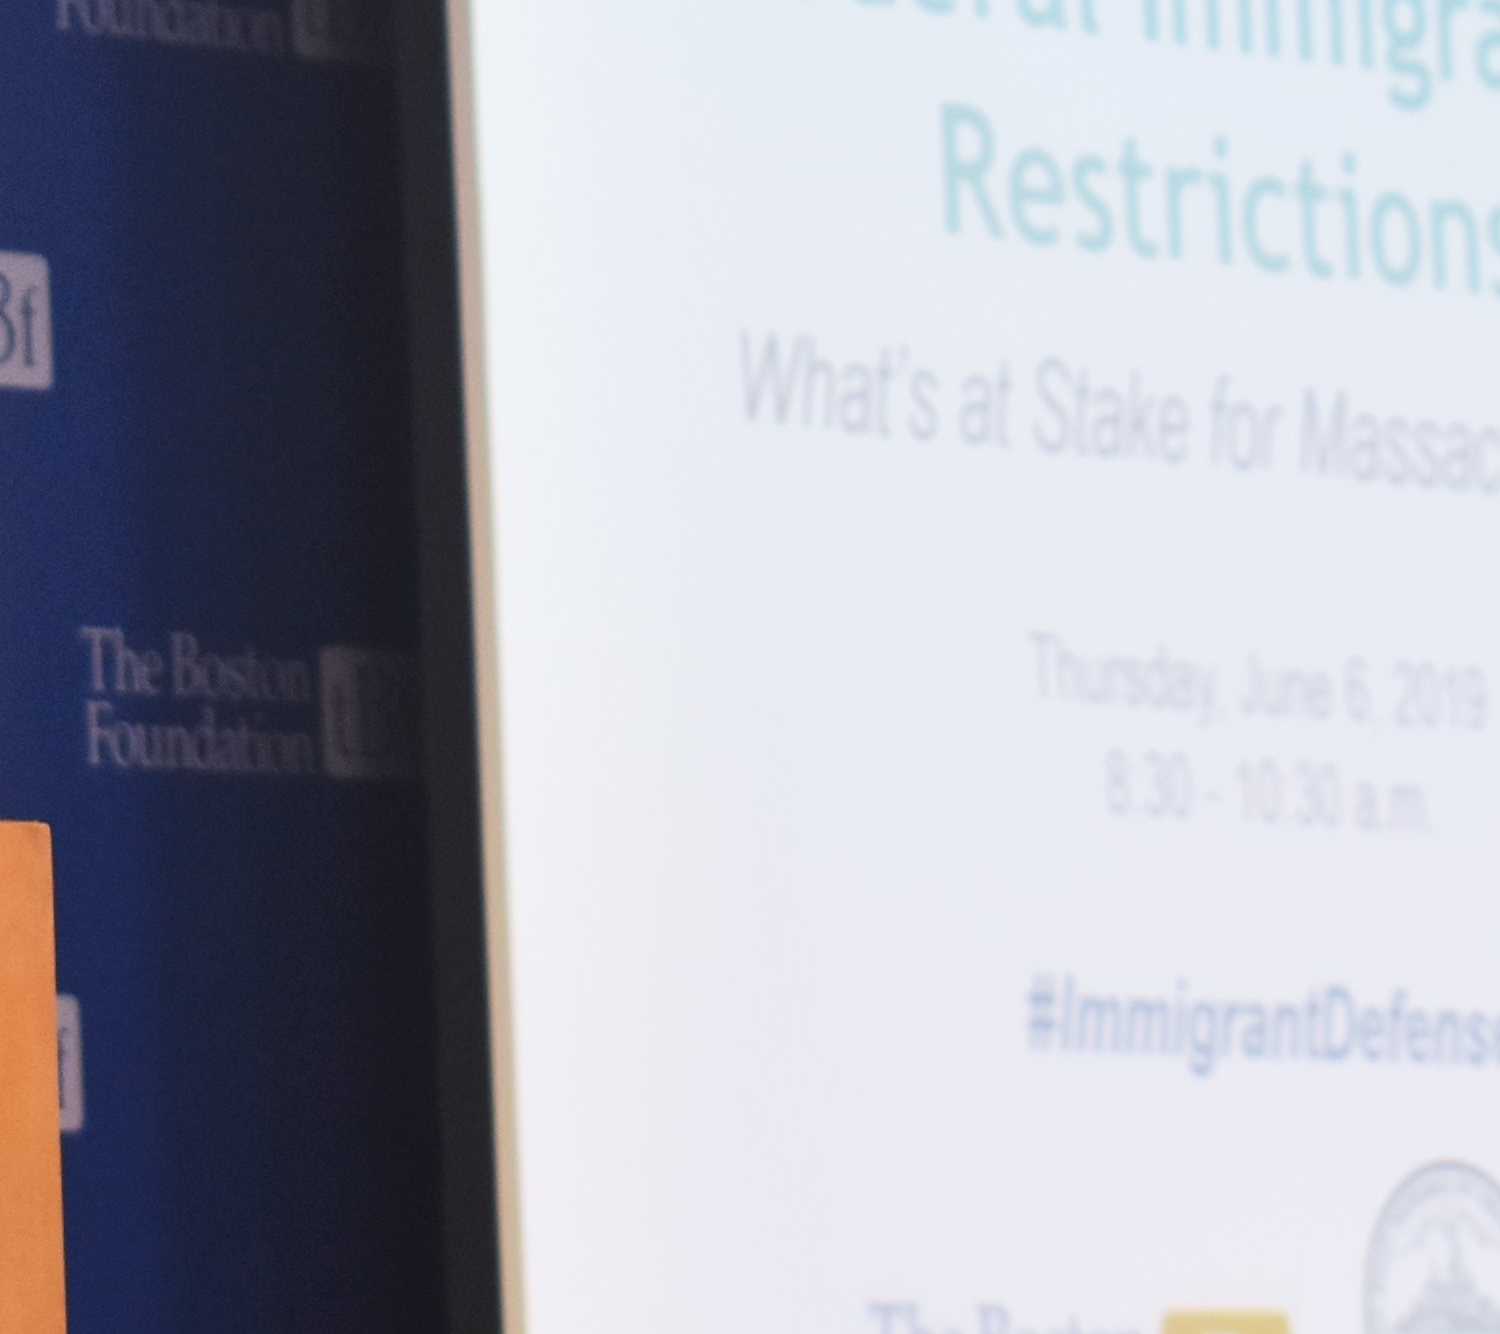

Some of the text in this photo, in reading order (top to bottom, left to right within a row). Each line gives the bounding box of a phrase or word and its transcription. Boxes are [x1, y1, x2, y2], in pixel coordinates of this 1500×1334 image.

[738, 325, 940, 442] What's
[958, 357, 1013, 449] at
[1031, 354, 1190, 468] Stake
[1207, 373, 1284, 474] for
[77, 624, 163, 696] The
[1237, 649, 1334, 720] June
[1391, 657, 1490, 733] 2019
